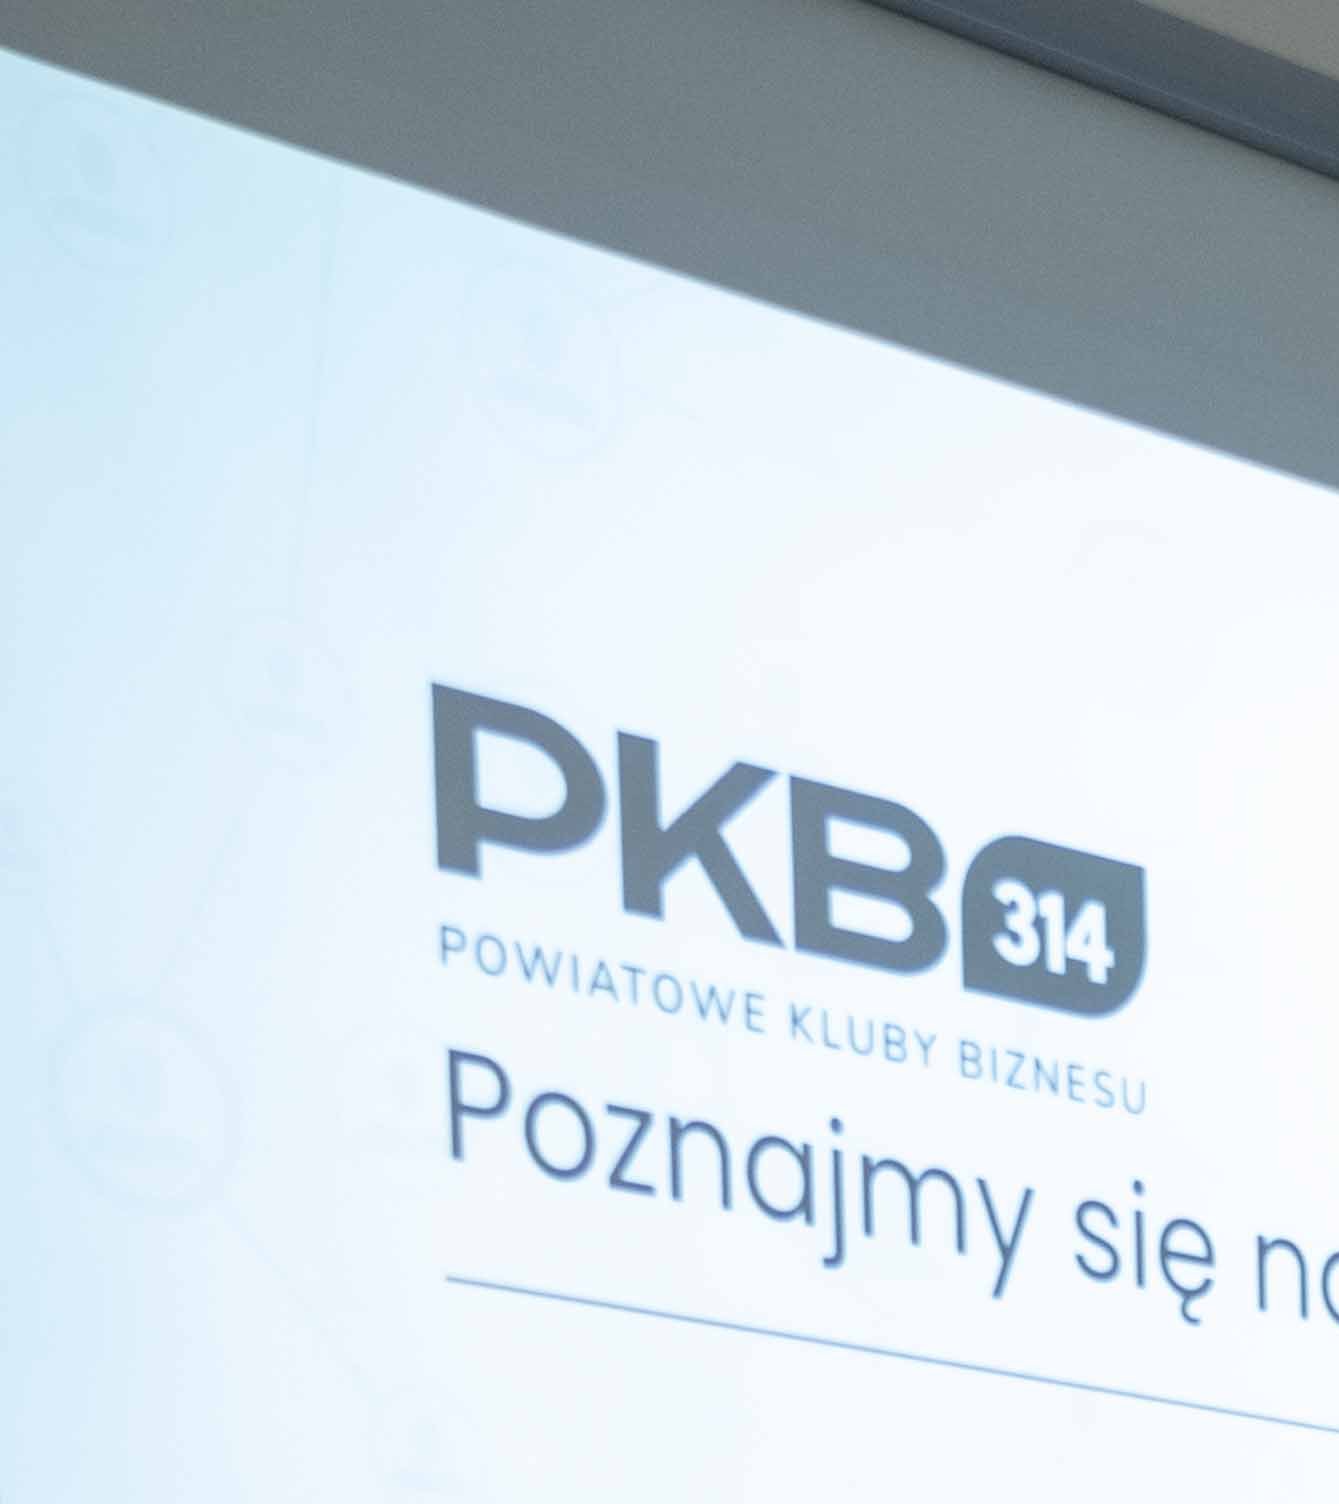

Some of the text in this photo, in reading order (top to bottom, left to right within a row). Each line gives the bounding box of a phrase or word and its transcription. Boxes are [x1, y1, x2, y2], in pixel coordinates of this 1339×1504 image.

[431, 682, 1115, 984] PKB 314
[440, 925, 1146, 1116] POWIATOWE KLUBY BIZNESU
[448, 1048, 1034, 1300] Poznajmy
[1074, 1180, 1214, 1326] się
